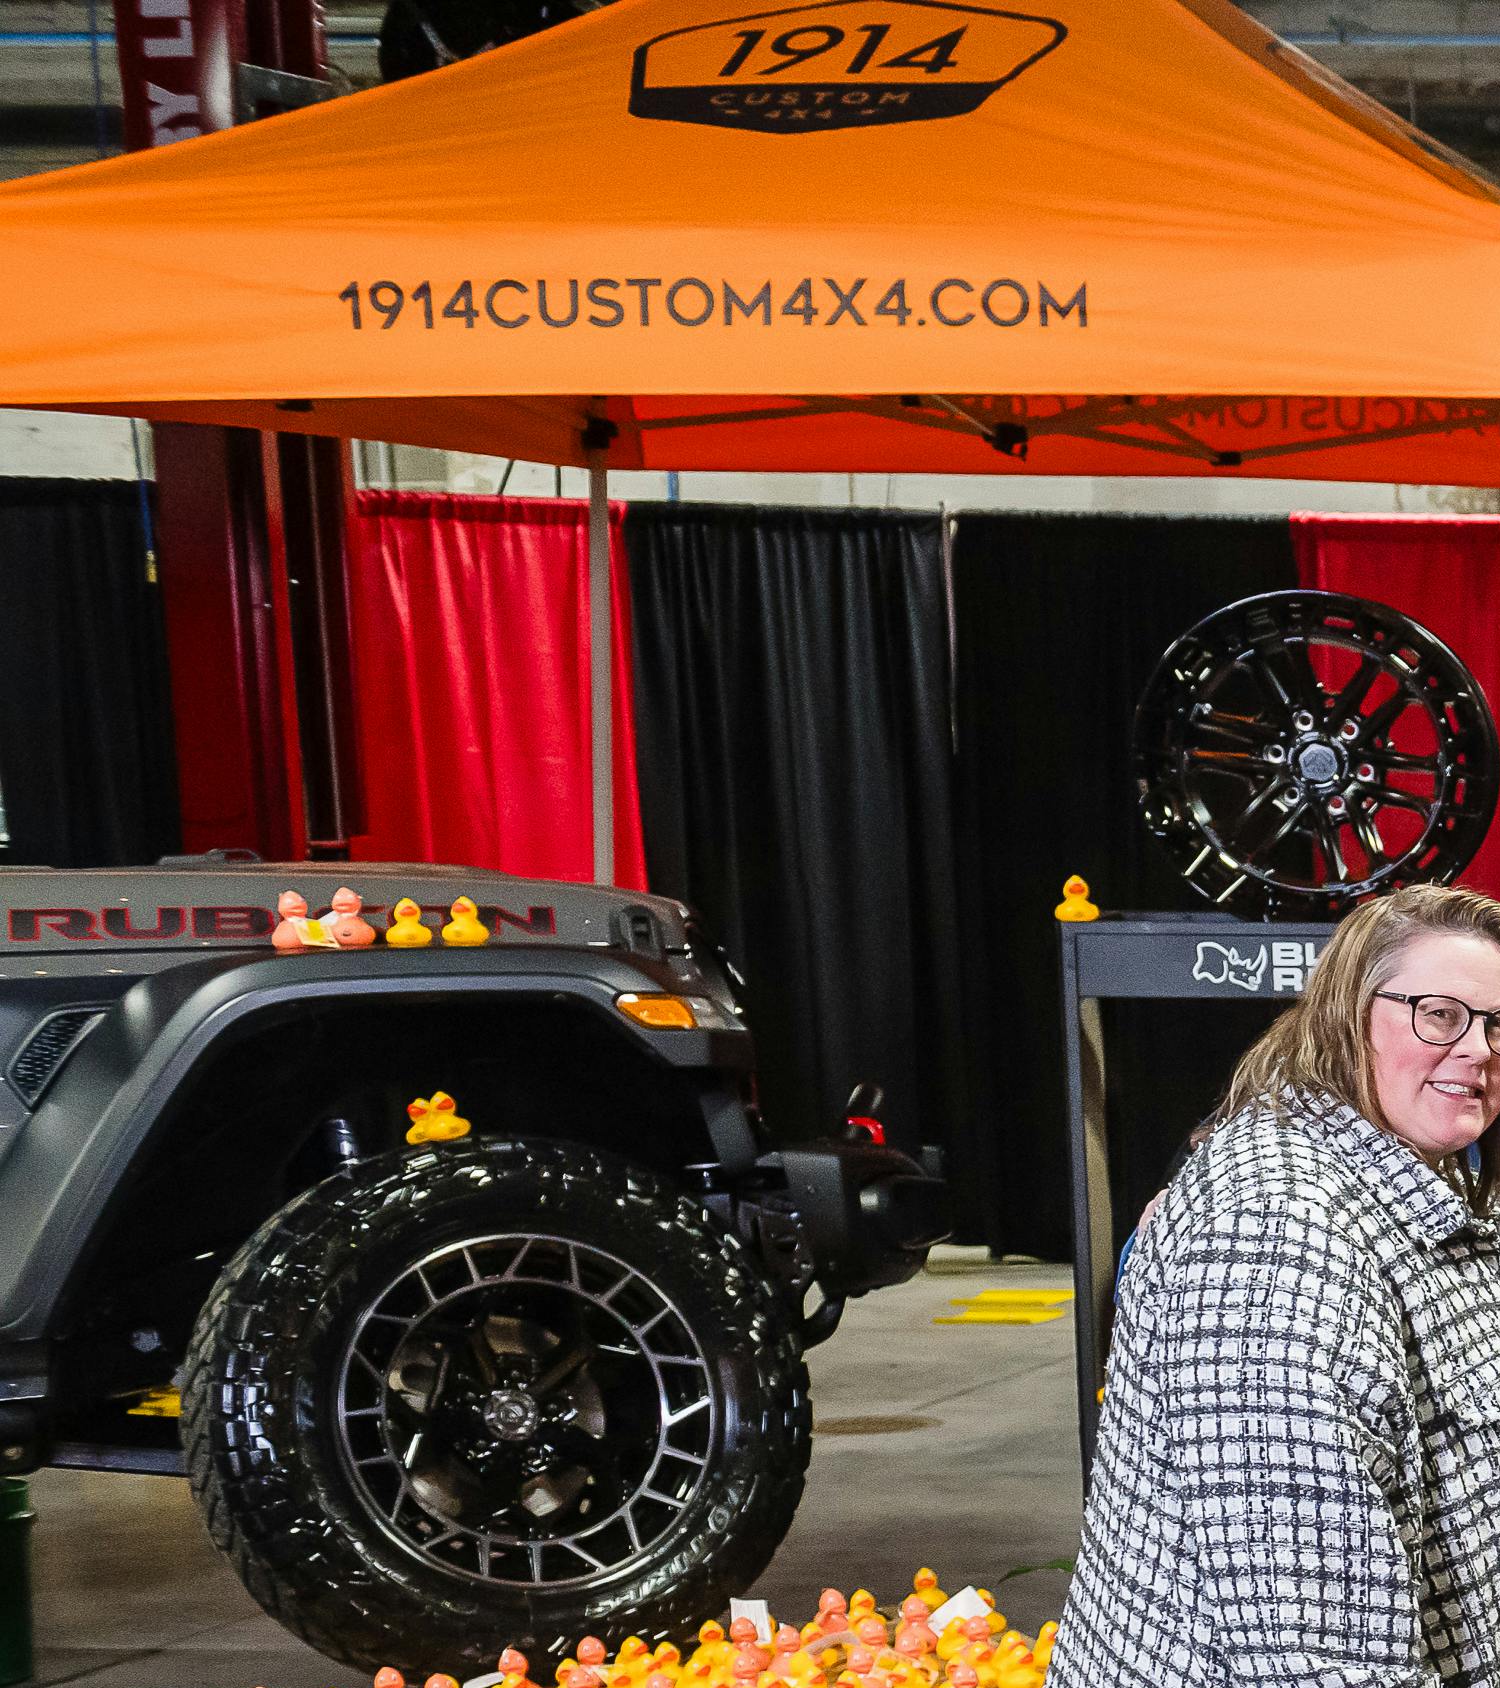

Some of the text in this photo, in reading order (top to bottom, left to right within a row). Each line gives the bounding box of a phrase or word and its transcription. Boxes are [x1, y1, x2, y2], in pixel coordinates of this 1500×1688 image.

[717, 23, 969, 77] 1914
[709, 91, 911, 106] CUSTOM
[338, 276, 1088, 330] 1914CUSTOM4X4.COM
[7, 905, 557, 943] RUBN
